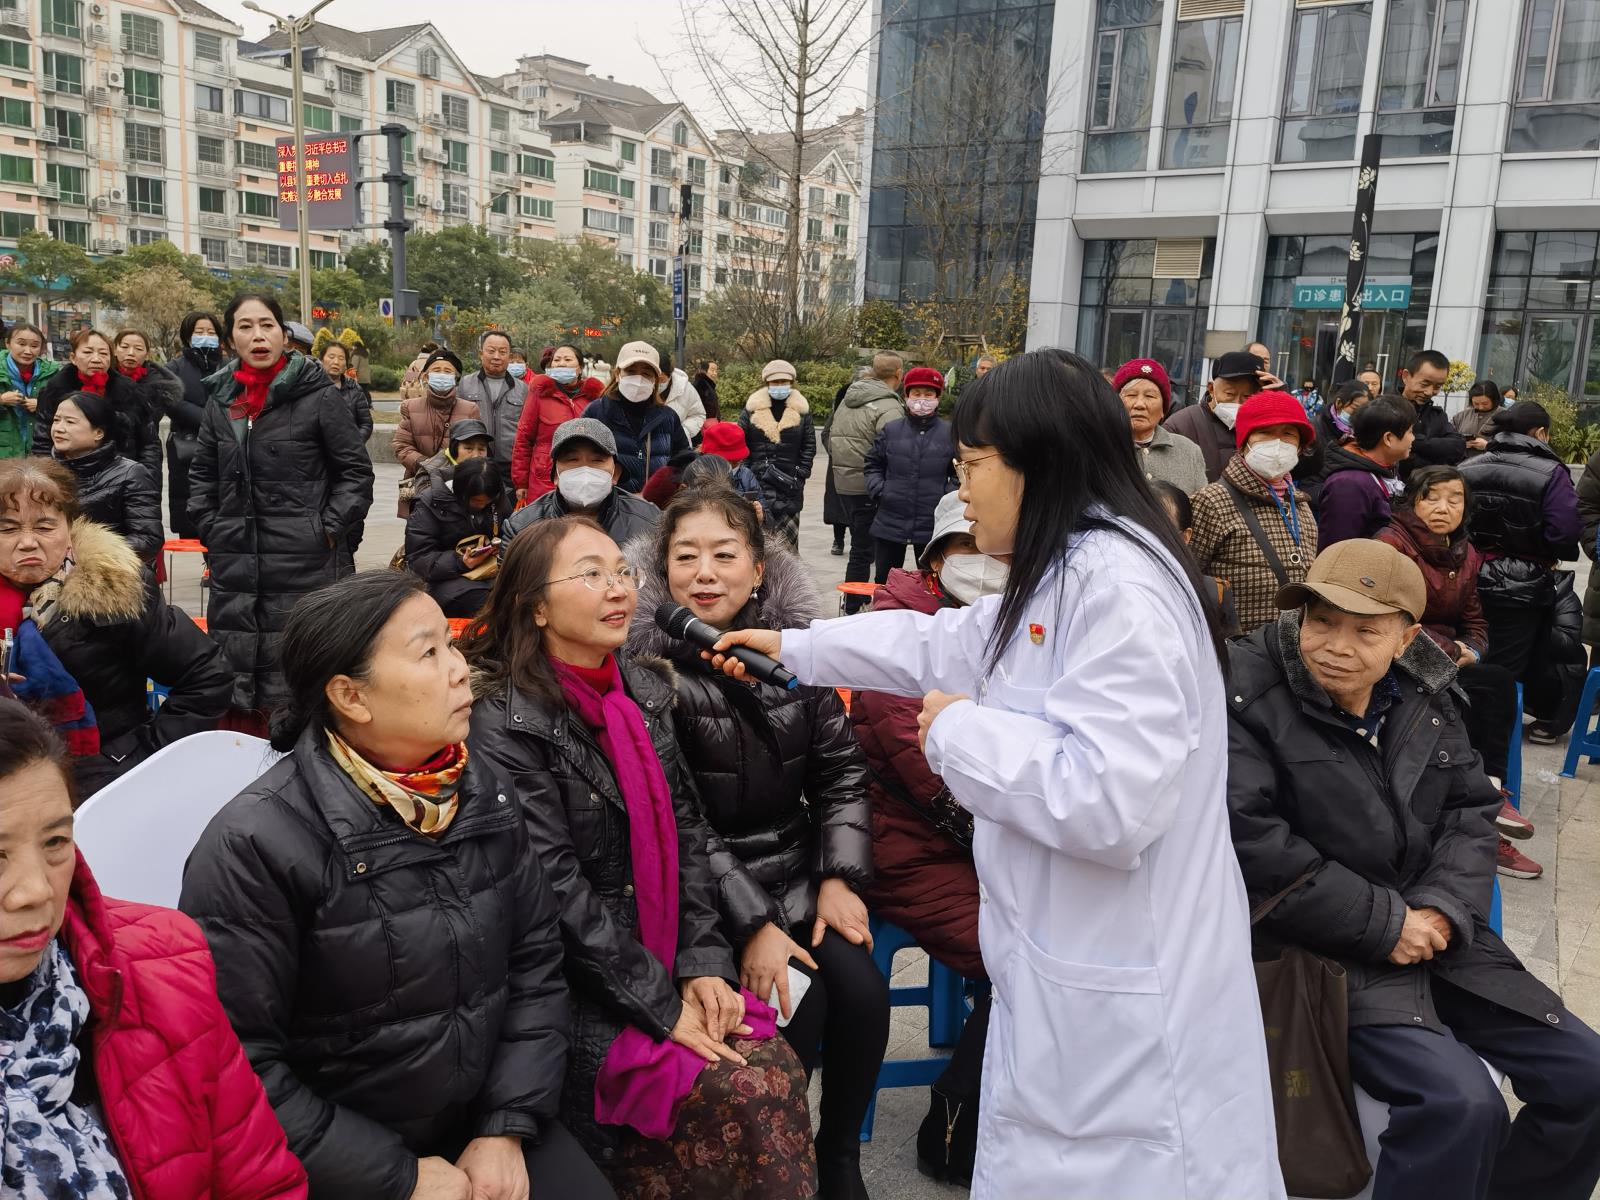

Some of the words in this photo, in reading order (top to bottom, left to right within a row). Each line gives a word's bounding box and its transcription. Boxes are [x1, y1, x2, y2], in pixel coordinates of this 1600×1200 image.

[278, 140, 347, 158] 深入习近平总书记
[280, 171, 349, 188] 以县重要切入点扎
[1298, 289, 1405, 302] 门诊患出入口
